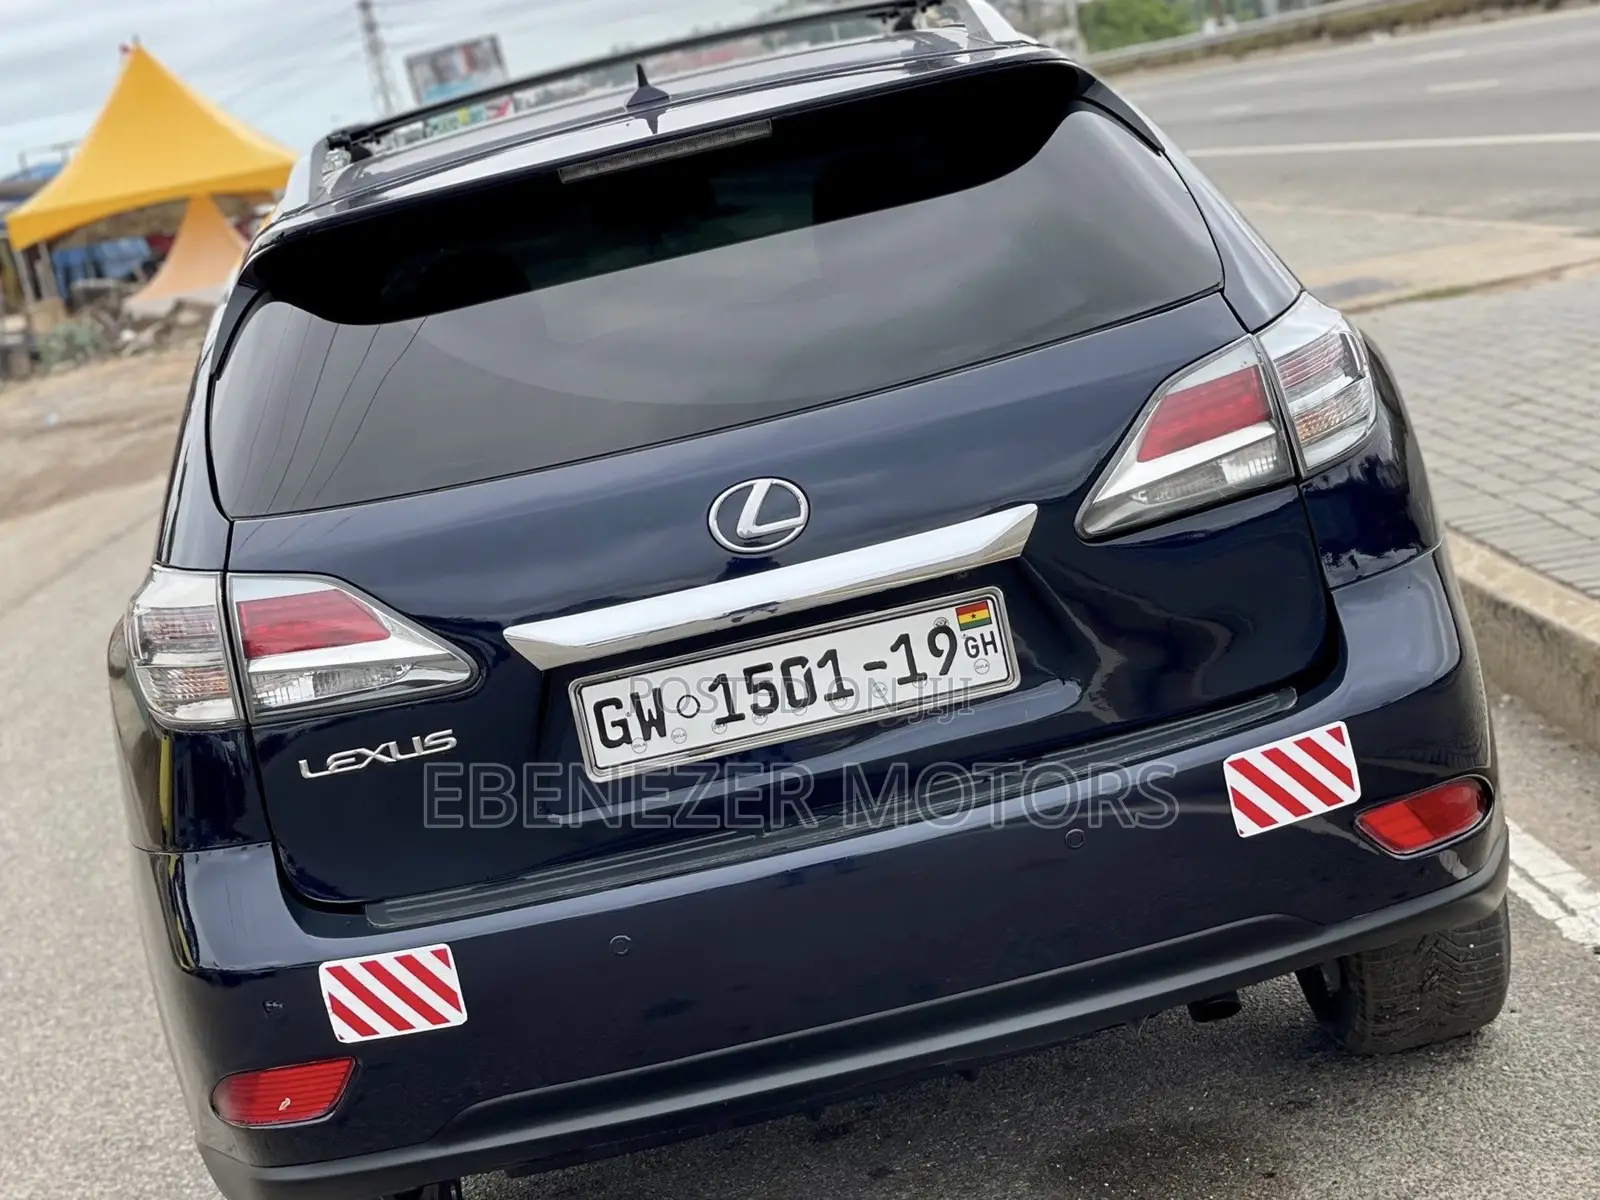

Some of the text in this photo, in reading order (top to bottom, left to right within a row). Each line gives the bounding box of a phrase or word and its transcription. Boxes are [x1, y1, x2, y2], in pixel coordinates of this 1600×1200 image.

[964, 631, 998, 659] GH
[592, 625, 958, 749] GW 1501-19
[298, 729, 457, 779] LEXUS
